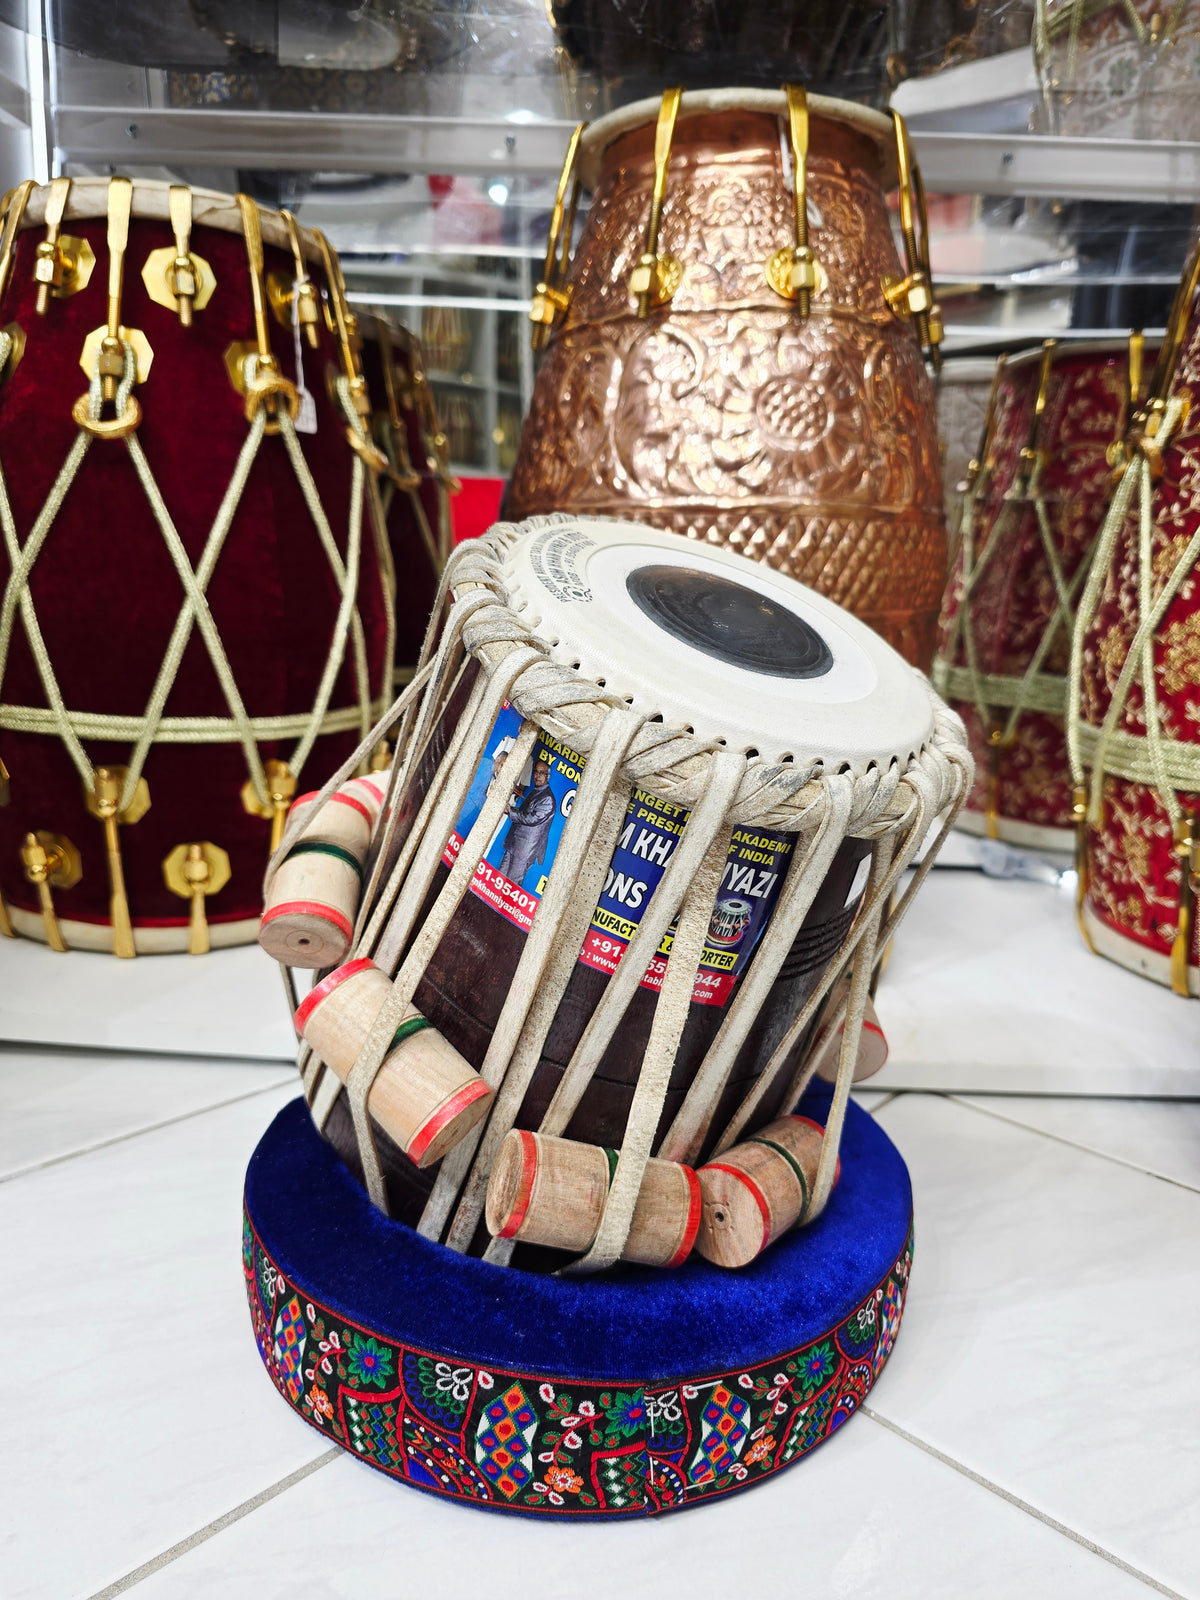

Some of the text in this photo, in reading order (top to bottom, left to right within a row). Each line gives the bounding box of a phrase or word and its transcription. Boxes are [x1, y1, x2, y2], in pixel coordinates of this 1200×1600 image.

[538, 749, 557, 766] BY
[738, 847, 775, 866] INDIA
[632, 789, 683, 818] NGEET
[732, 830, 792, 854] AKADEMI
